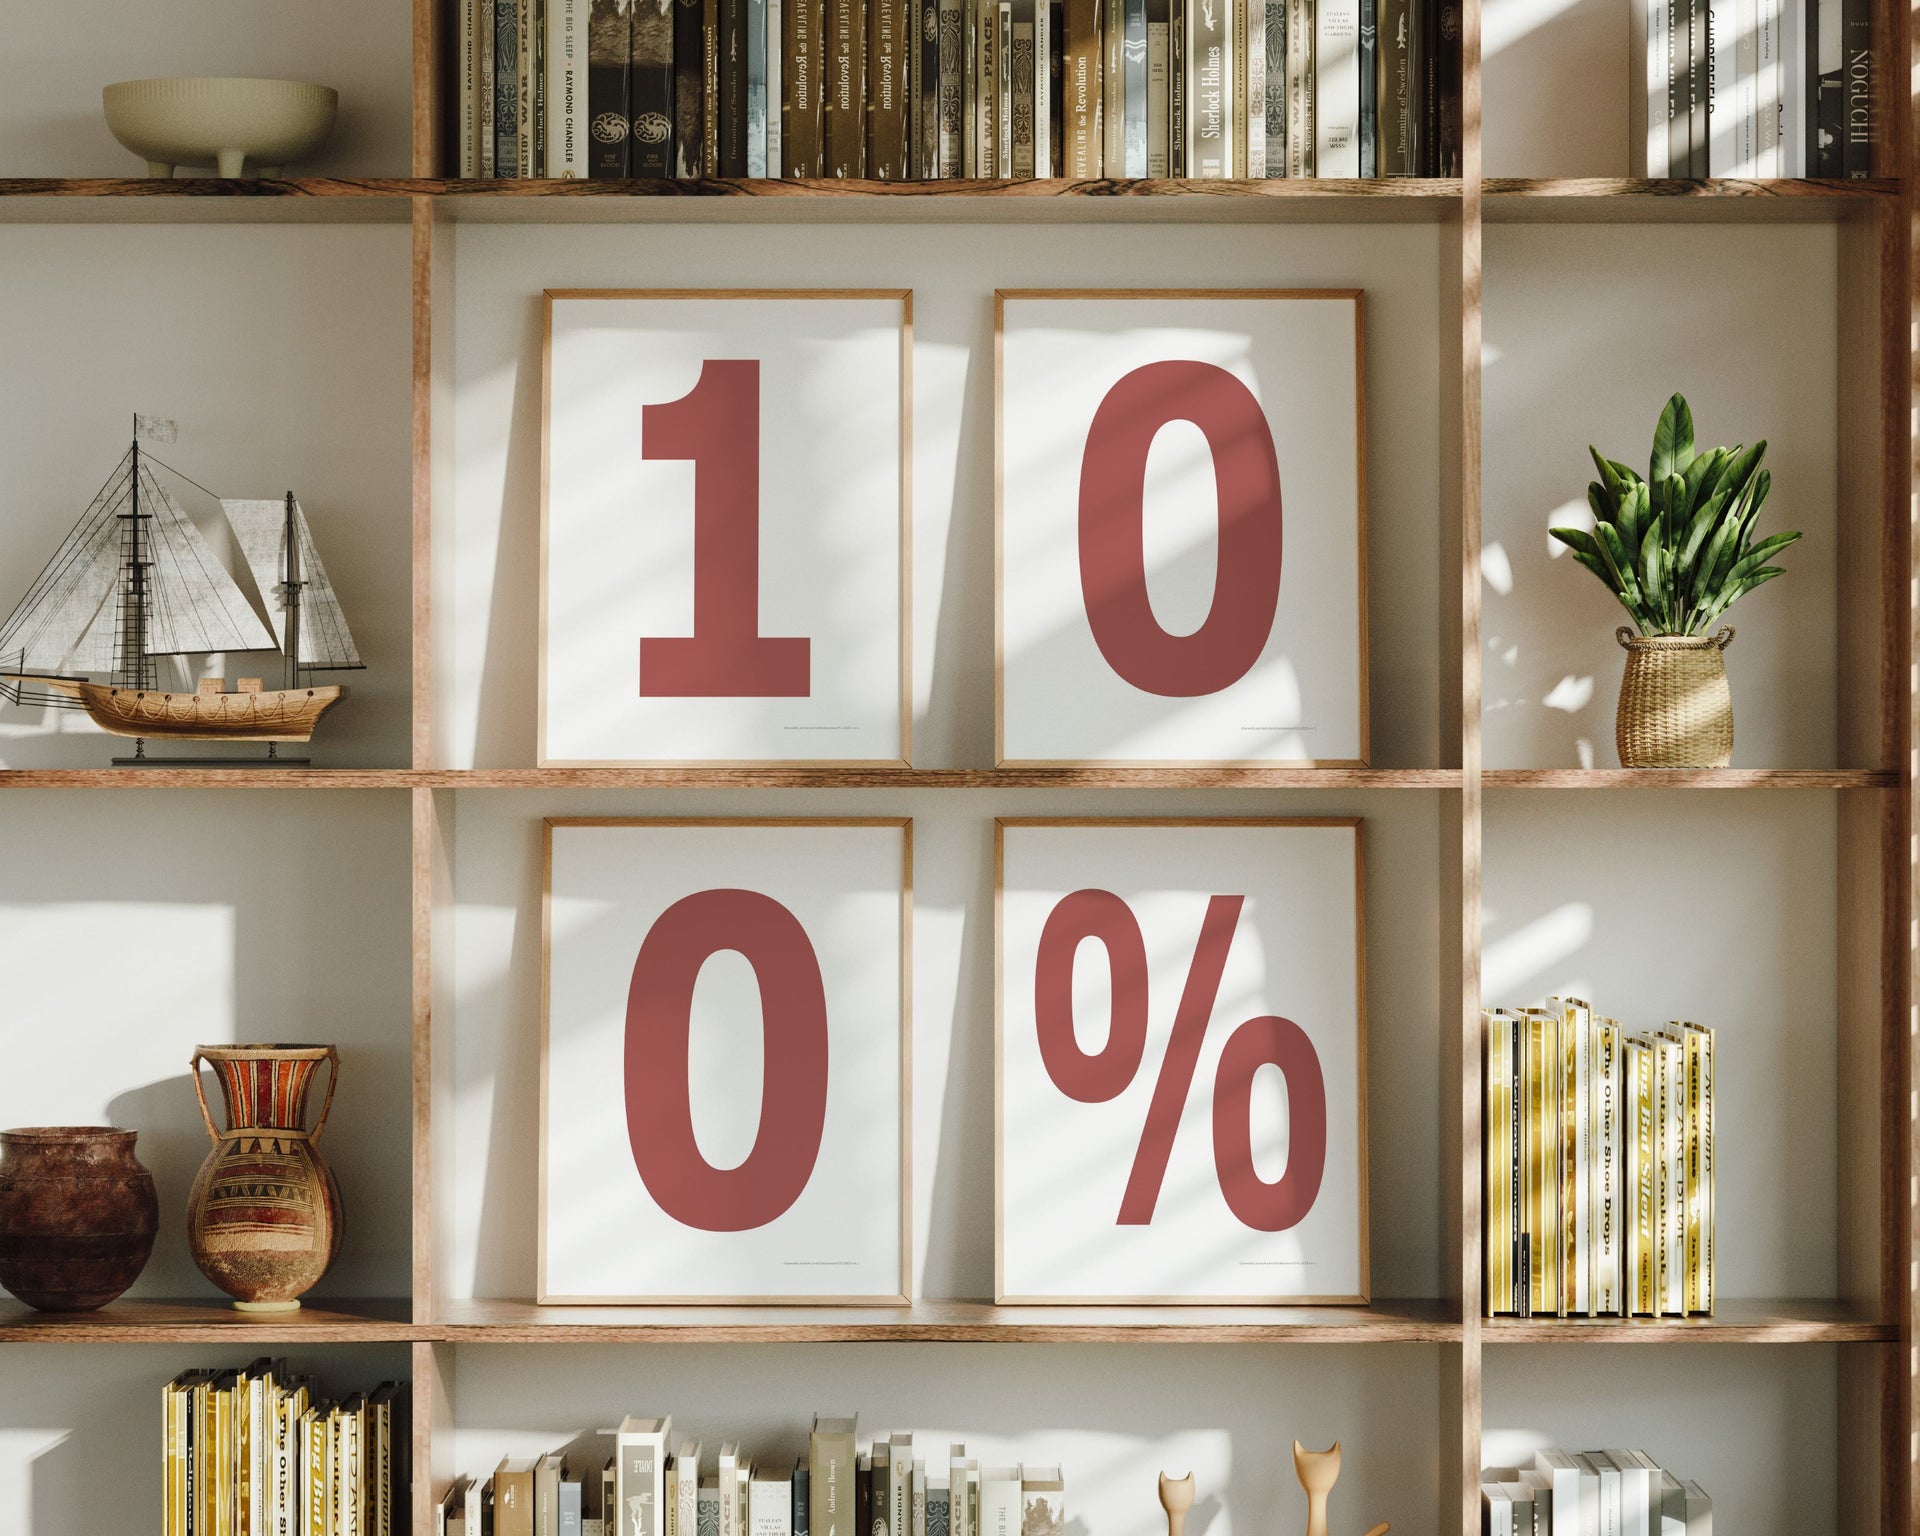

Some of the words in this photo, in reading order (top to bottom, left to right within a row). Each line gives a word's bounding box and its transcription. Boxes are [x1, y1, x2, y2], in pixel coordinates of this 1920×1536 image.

[984, 17, 993, 77] PEACE
[1202, 46, 1220, 87] Holmes
[1075, 56, 1087, 112] Revolution
[1397, 58, 1406, 95] Sweden
[1850, 49, 1868, 144] NOGUCHI
[984, 94, 993, 140] WAR
[1078, 115, 1087, 127] the
[1202, 91, 1220, 138] Sherlock
[1397, 96, 1406, 106] of
[1397, 107, 1406, 153] Dreaming
[1077, 130, 1086, 179] REVEALING
[640, 360, 810, 697] 1
[1078, 359, 1283, 697] 0
[624, 888, 828, 1232] 0
[1035, 888, 1327, 1232] %
[1604, 1042, 1613, 1079] The
[1604, 1084, 1613, 1141] Other
[1638, 1104, 1651, 1154] But
[1692, 1114, 1697, 1131] of
[1604, 1145, 1613, 1193] Shoe
[1638, 1159, 1651, 1239] Silent
[1604, 1197, 1613, 1256] Drops
[634, 1460, 653, 1473] DOYLE
[828, 1459, 836, 1483] Brown
[310, 1476, 323, 1526] But
[828, 1485, 836, 1514] Andrew
